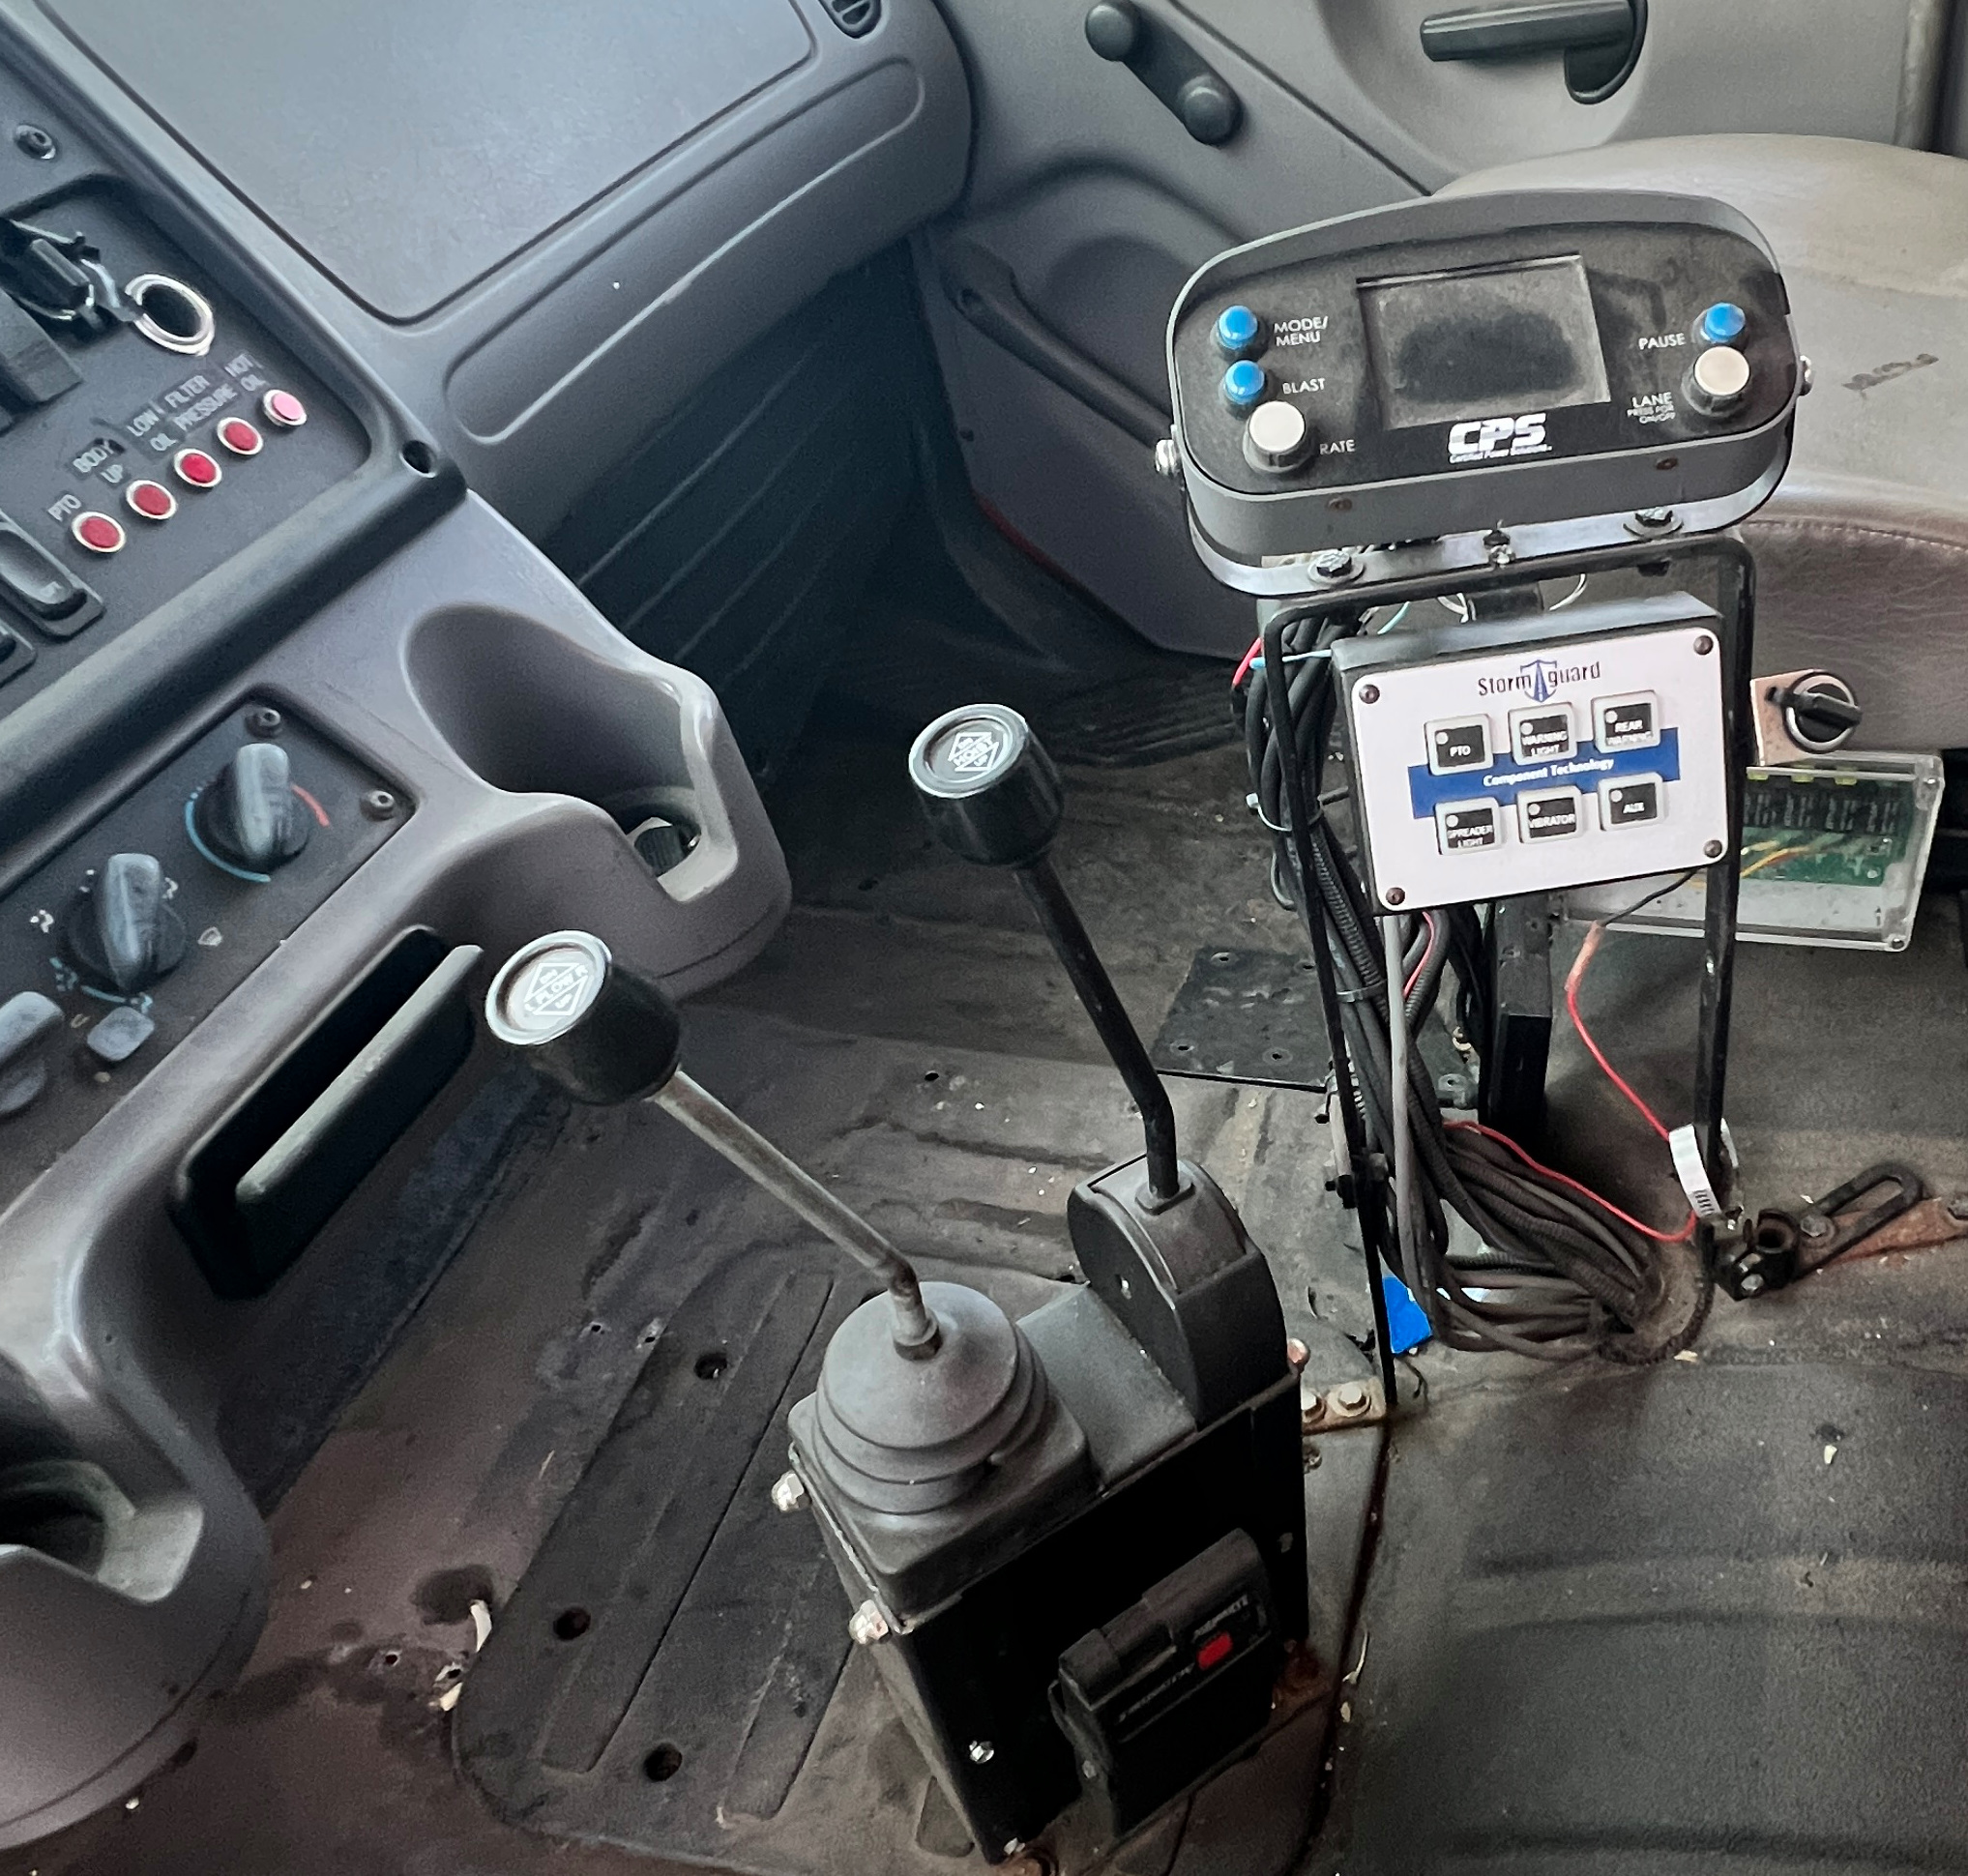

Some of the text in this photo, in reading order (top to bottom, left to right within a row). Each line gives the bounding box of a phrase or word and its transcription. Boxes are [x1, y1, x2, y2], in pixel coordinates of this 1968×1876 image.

[1274, 316, 1329, 333] MODE/
[1277, 331, 1321, 346] MENU
[1638, 333, 1686, 350] PAUSE
[164, 375, 211, 408] FILTER
[1282, 378, 1326, 395] BLAST
[172, 383, 238, 431] PRESSURE
[1631, 392, 1673, 408] LANE
[1448, 412, 1547, 454] CPS
[73, 438, 115, 473] BODY
[1319, 439, 1356, 454] RATE
[100, 463, 124, 484] UP
[47, 493, 82, 522] PTO
[1478, 661, 1601, 696] Storm guard
[1449, 745, 1472, 757] PTO
[1483, 758, 1614, 787] Component Technology
[1529, 813, 1576, 829] VIBRATOR
